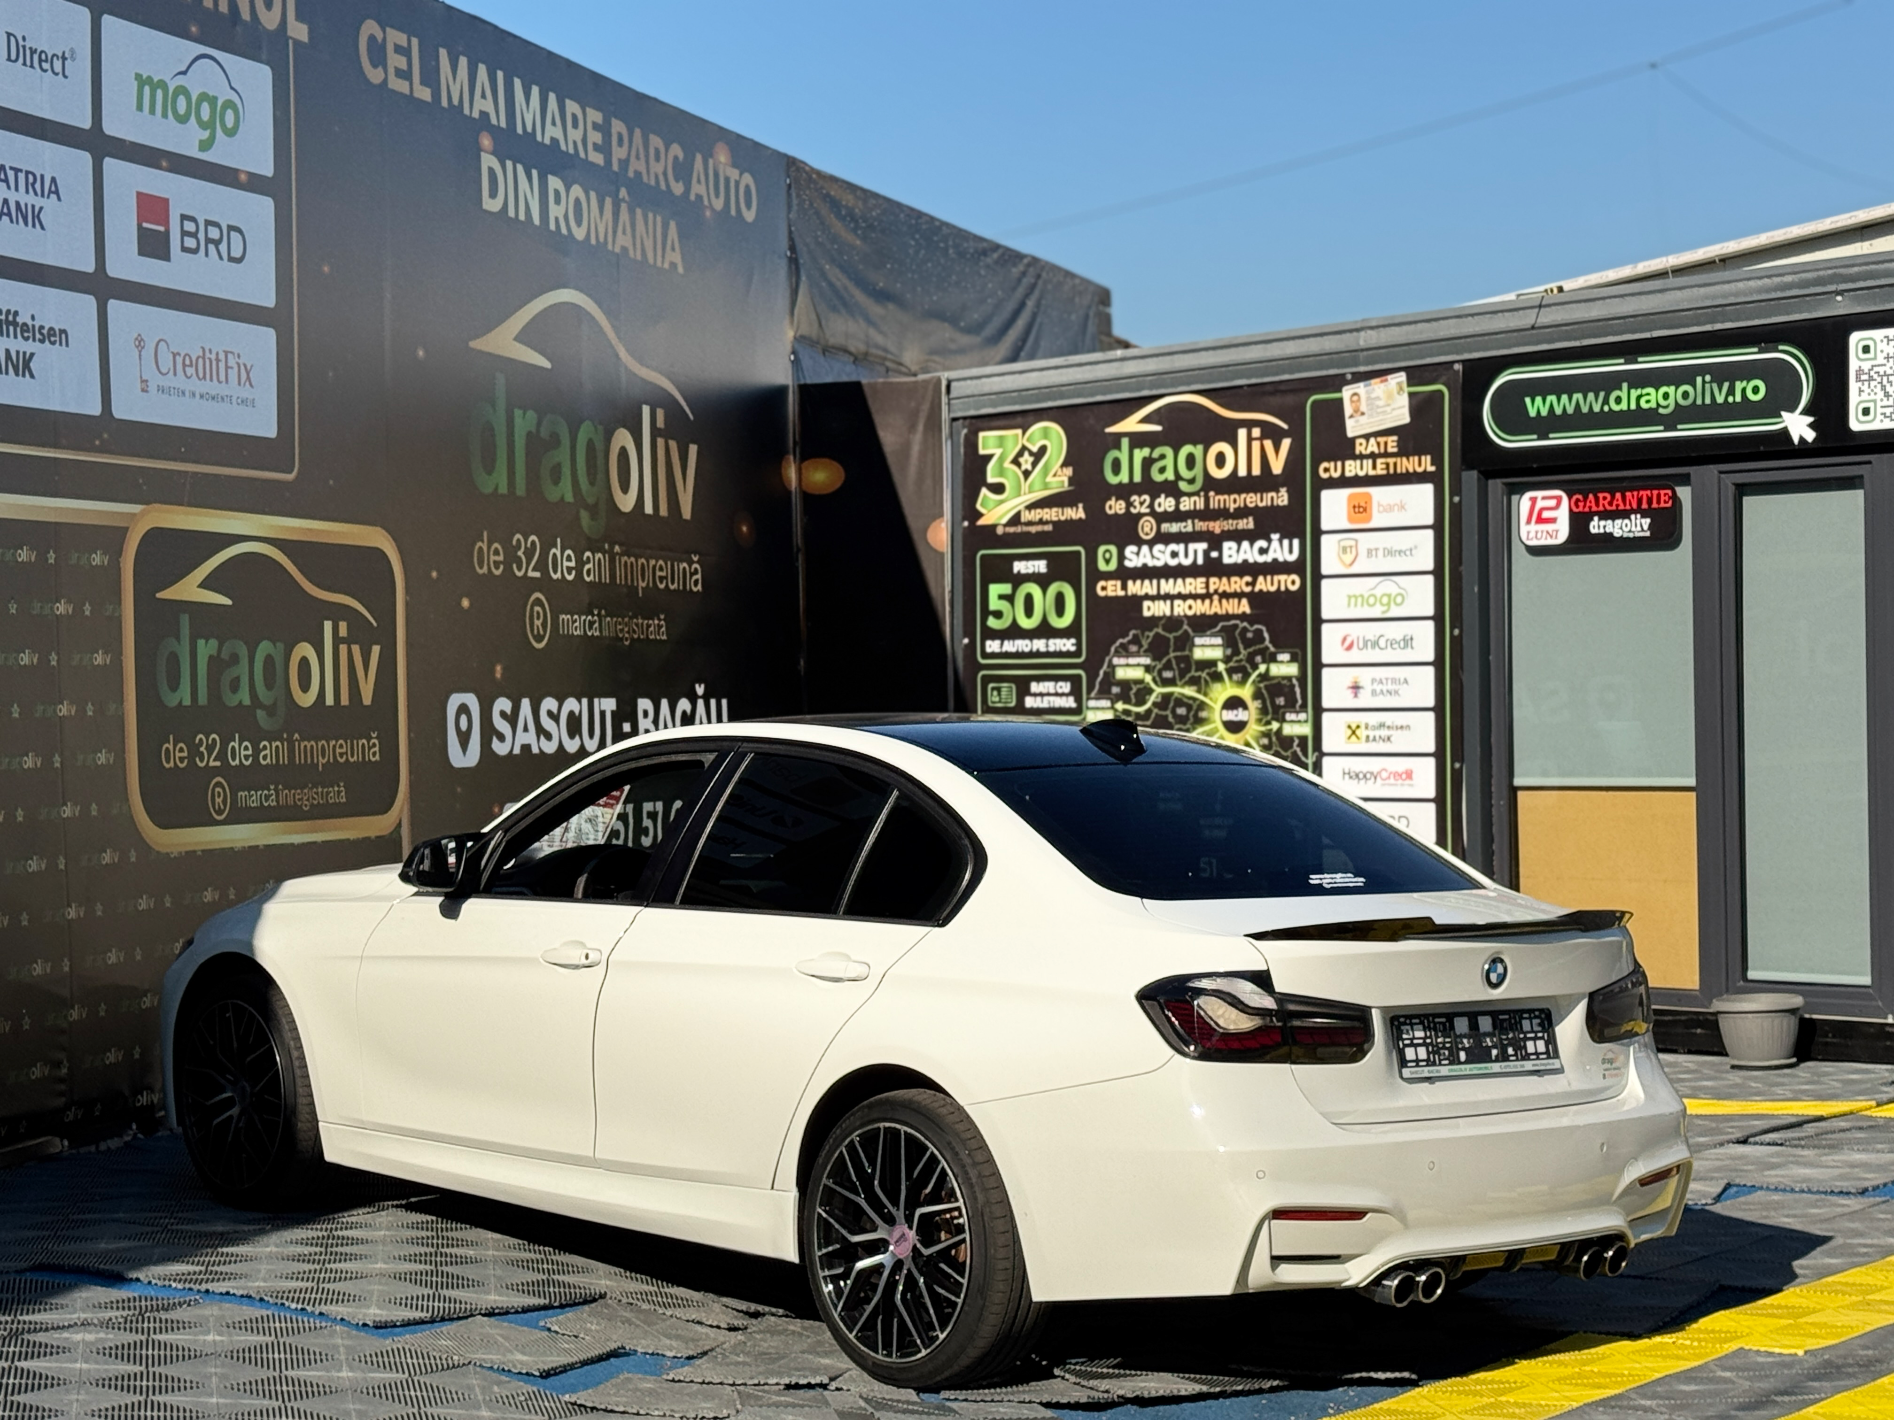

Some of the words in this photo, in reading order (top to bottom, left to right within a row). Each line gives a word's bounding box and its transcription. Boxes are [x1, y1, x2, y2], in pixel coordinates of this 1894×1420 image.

[134, 71, 241, 152] mogo
[359, 19, 432, 102] CEL
[439, 47, 507, 129] MAI
[514, 76, 605, 167] MARE
[611, 118, 685, 197] PARC
[690, 152, 758, 224] AUTO
[480, 151, 541, 227] DIN
[548, 174, 684, 274] ROMÂNIA
[179, 213, 248, 265] BRD
[154, 338, 254, 389] CreditFix
[157, 384, 186, 398] PRIETEN
[188, 388, 196, 399] IN
[199, 392, 234, 405] MOMENTE
[236, 396, 257, 408] CHEIE
[1524, 374, 1767, 418] www.dragoliv.ro
[469, 372, 699, 539] dragoliv
[1355, 436, 1398, 456] RATE
[1103, 427, 1292, 492] dragoliv
[1319, 461, 1342, 479] CU
[1345, 455, 1436, 477] BULETINUL
[1105, 496, 1126, 515] de
[1130, 494, 1150, 513] 32
[1154, 494, 1176, 513] de
[1179, 492, 1204, 511] ani
[1208, 487, 1289, 513] împreună
[1351, 501, 1368, 514] tbi
[1377, 499, 1408, 514] bank
[1525, 494, 1563, 527] 12
[1570, 489, 1673, 513] GARANTIE
[1160, 519, 1193, 534] marcă
[1194, 516, 1255, 535] înregistrată
[1526, 529, 1560, 541] LUNI
[1589, 514, 1651, 538] dragoliv
[1124, 542, 1208, 568] SASCUT
[1222, 533, 1300, 564] BACĂU
[1366, 548, 1379, 559] BT
[474, 530, 504, 575] de
[512, 533, 541, 578] 32
[548, 537, 576, 581] de
[583, 543, 610, 584] ani
[614, 544, 703, 598] împreună
[1013, 560, 1048, 574] PESTE
[1096, 580, 1125, 597] CEL
[1127, 578, 1158, 596] MAI
[1160, 577, 1207, 595] MARE
[1209, 575, 1252, 594] PARC
[1254, 573, 1301, 592] AUTO
[986, 581, 1076, 630] 500
[1142, 600, 1171, 617] DIN
[1173, 594, 1251, 616] ROMÂNIA
[1347, 592, 1405, 614] mogo
[559, 609, 600, 636] marcă
[601, 609, 668, 646] înregistrată
[985, 640, 1001, 653] DE
[1002, 639, 1032, 652] AUTO
[1032, 638, 1047, 652] PE
[1048, 638, 1077, 651] STOC
[1356, 634, 1414, 651] UniCredit
[156, 613, 381, 731] dragoliv
[1371, 677, 1410, 688] PATRIA
[1030, 681, 1055, 694] RATE
[1056, 681, 1071, 694] CU
[1371, 688, 1401, 698] BANK
[1024, 696, 1077, 708] BULETINUL
[491, 697, 617, 756] SASCUT
[1364, 722, 1411, 732] Raiffeisen
[1364, 733, 1393, 744] BANK
[161, 735, 188, 769] de
[195, 733, 221, 767] 32
[227, 733, 253, 766] de
[259, 732, 288, 765] ani
[293, 731, 380, 771] împreună
[1342, 768, 1415, 785] HappyCredit
[237, 784, 277, 808] marcă
[278, 782, 346, 811] înregistrată
